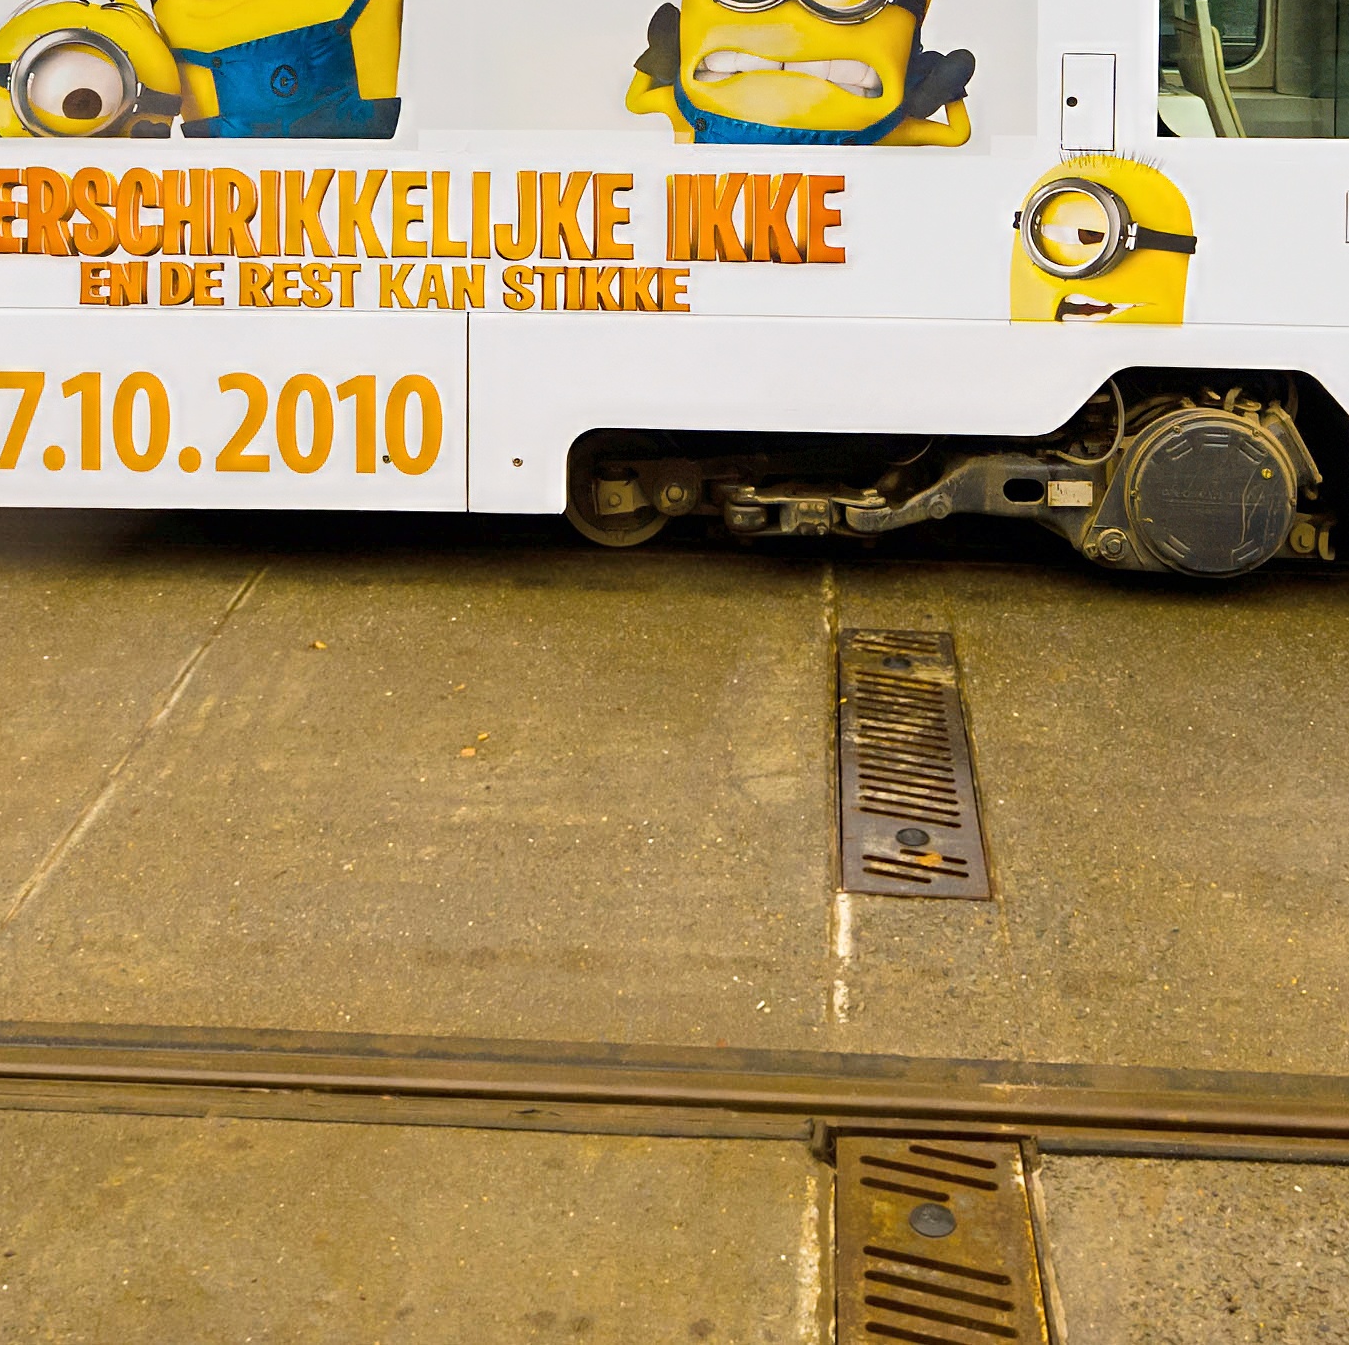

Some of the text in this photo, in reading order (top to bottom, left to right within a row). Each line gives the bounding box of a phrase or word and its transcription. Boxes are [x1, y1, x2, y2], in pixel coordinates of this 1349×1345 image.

[665, 172, 847, 265] IKKE
[79, 260, 692, 313] EN DE REST KAN STIKKE
